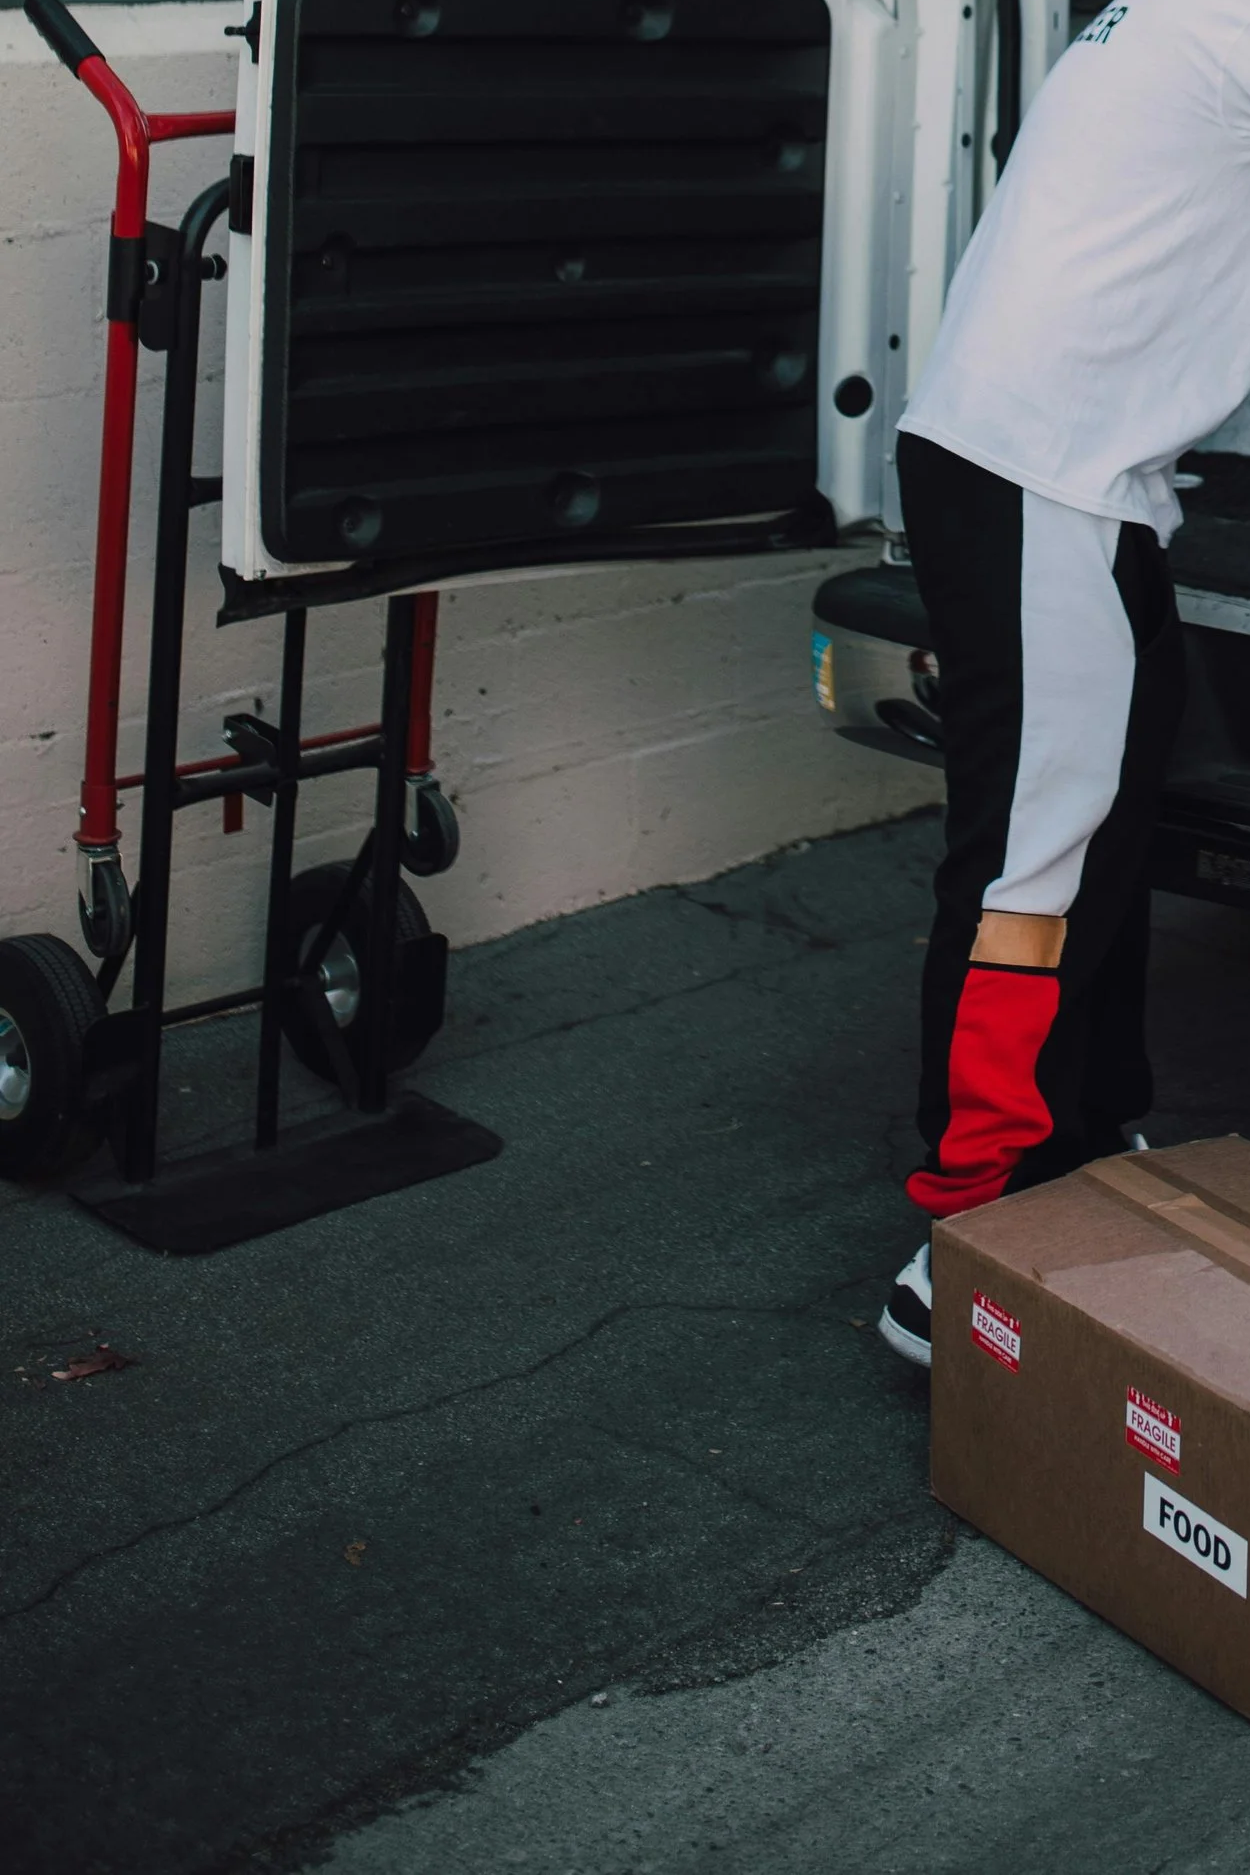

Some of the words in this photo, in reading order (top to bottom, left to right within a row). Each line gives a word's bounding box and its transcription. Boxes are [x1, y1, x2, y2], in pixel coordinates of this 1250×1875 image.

[976, 1312, 1017, 1353] FRAGILE
[1131, 1409, 1176, 1453] FRAGILE
[1159, 1496, 1231, 1571] FOOD
